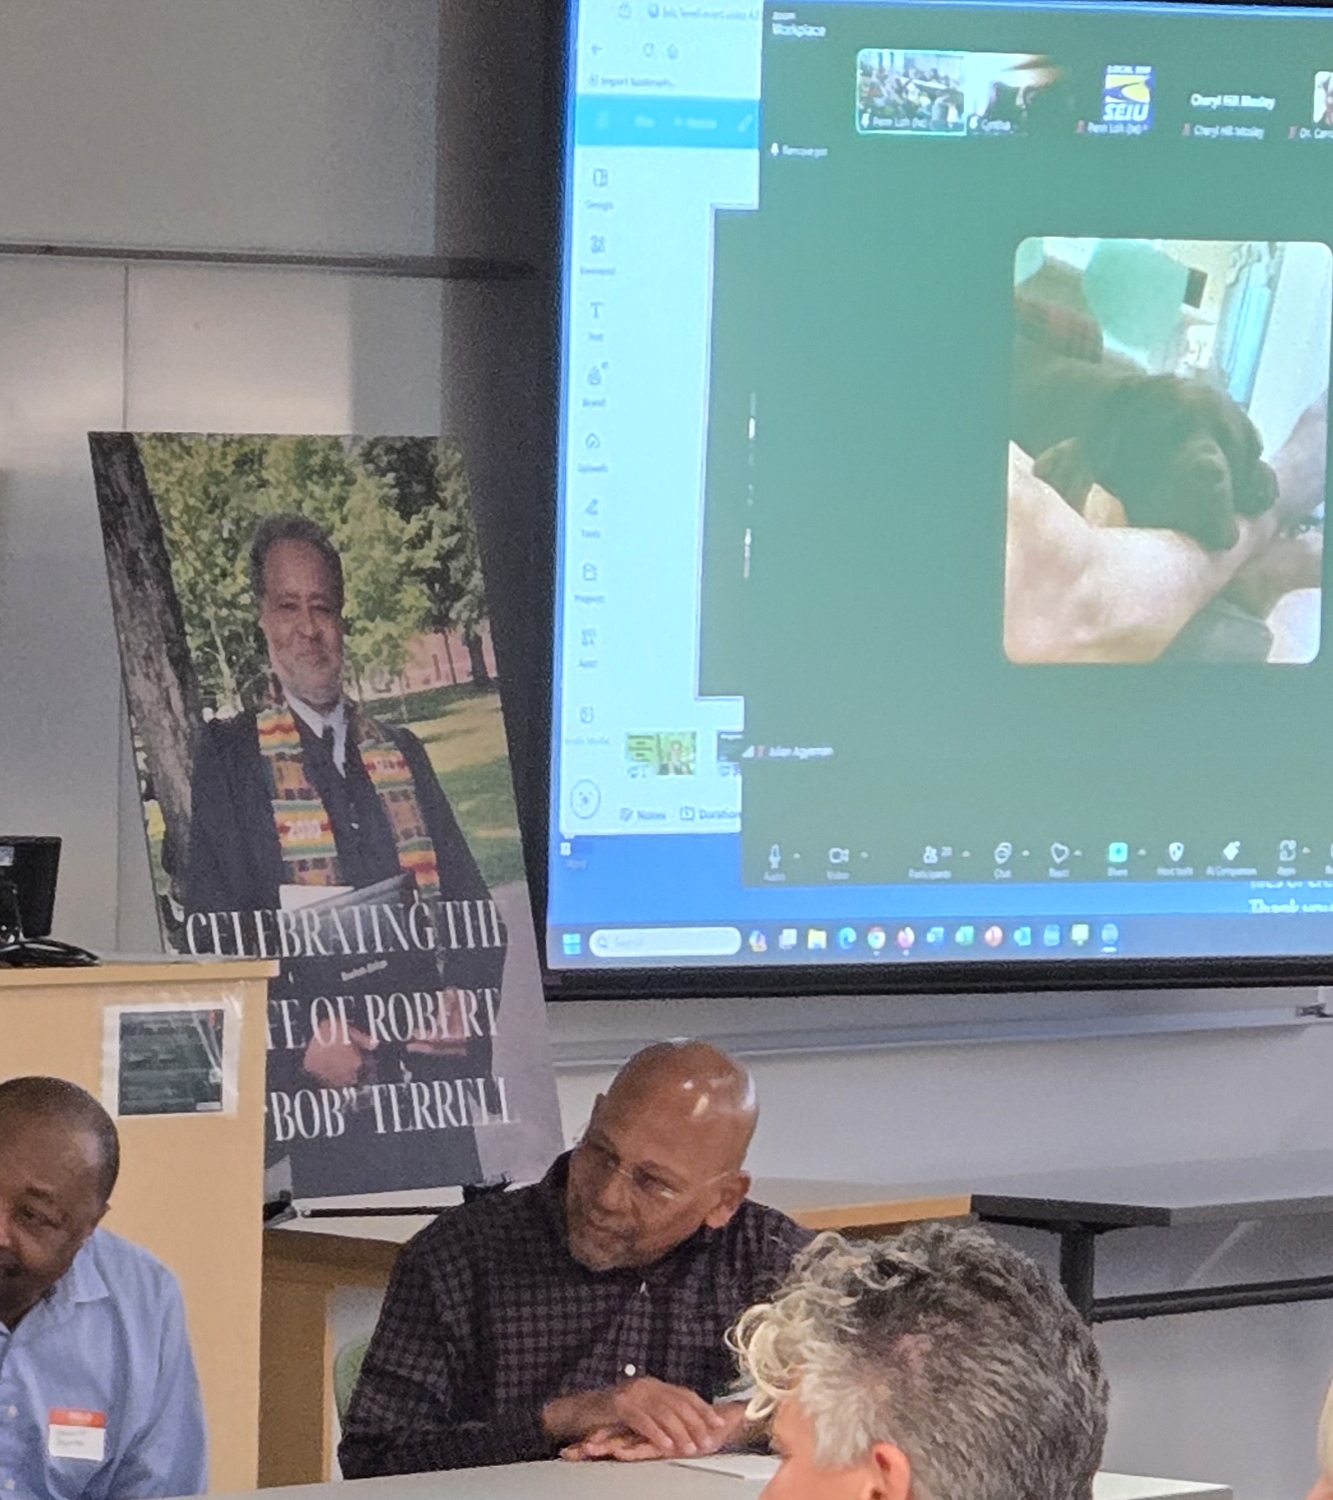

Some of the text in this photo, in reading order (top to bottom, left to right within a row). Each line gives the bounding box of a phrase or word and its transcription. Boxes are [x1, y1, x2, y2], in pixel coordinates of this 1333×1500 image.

[772, 23, 827, 38] Workplace
[1103, 103, 1150, 121] SEIU
[185, 900, 436, 959] CELEBRATING
[265, 986, 501, 1051] FE OF ROBERT
[264, 1075, 521, 1142] BOB” TERRELL
